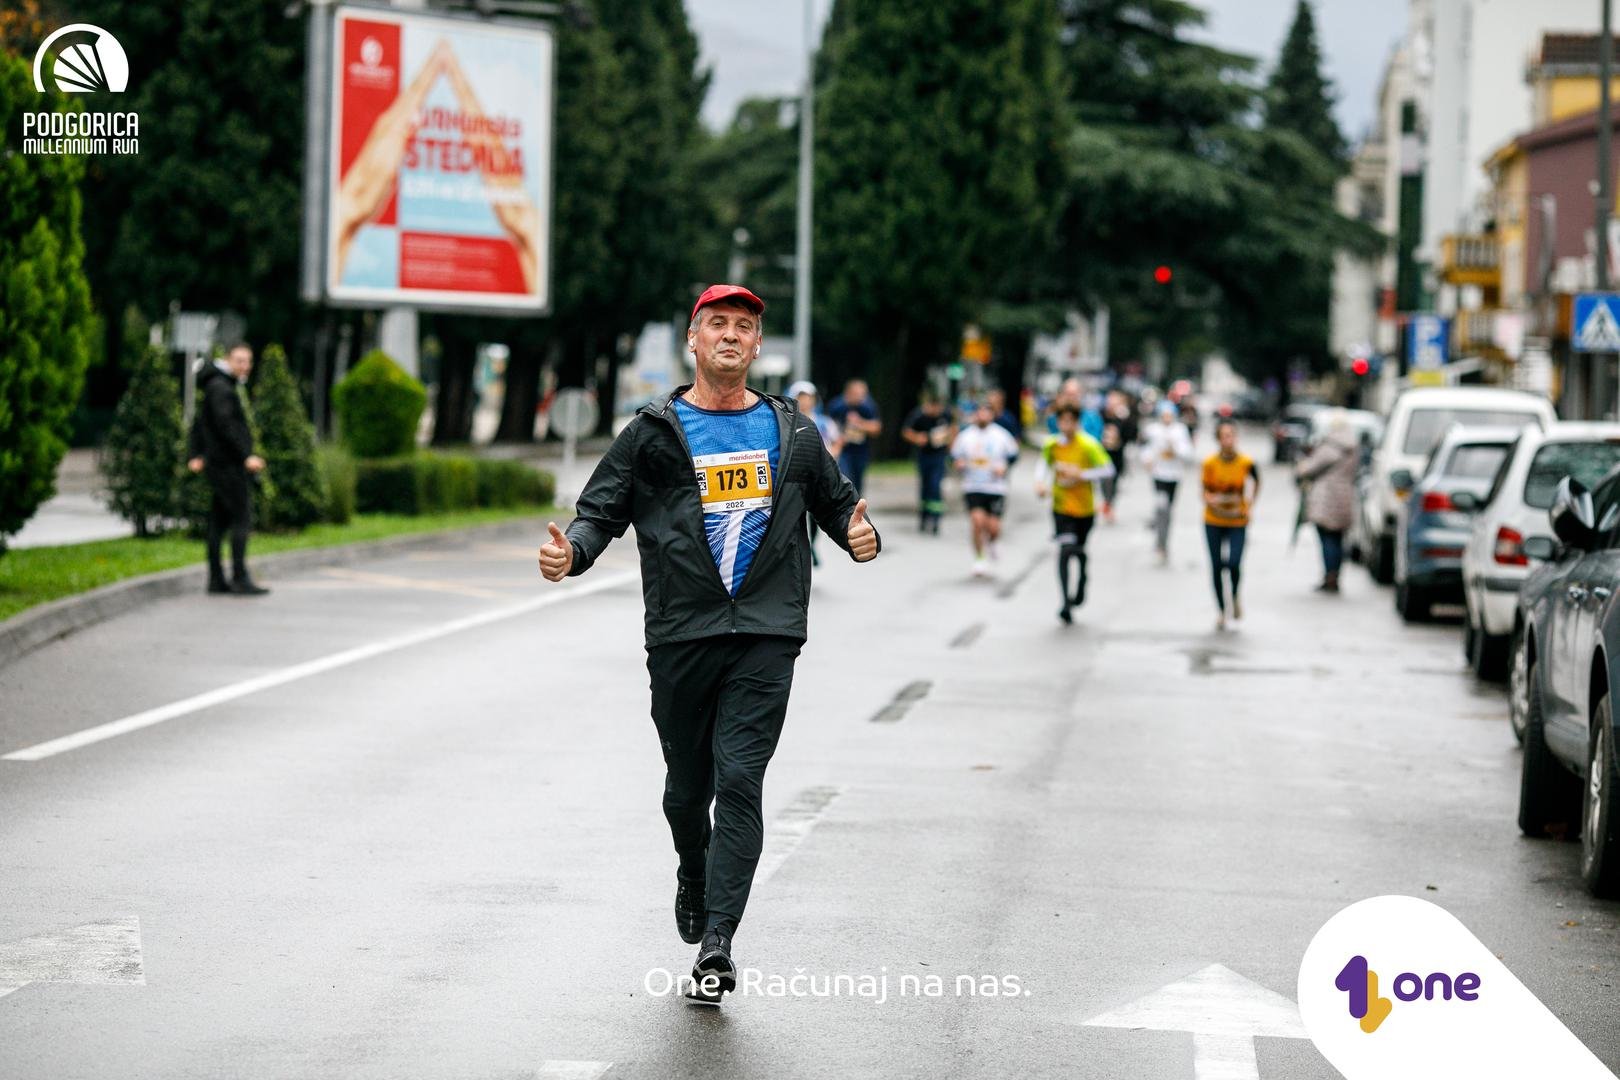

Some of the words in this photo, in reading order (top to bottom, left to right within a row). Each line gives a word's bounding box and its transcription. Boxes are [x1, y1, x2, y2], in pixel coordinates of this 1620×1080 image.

[729, 453, 766, 462] meridianbet
[716, 468, 748, 491] 173
[725, 501, 745, 509] 2022
